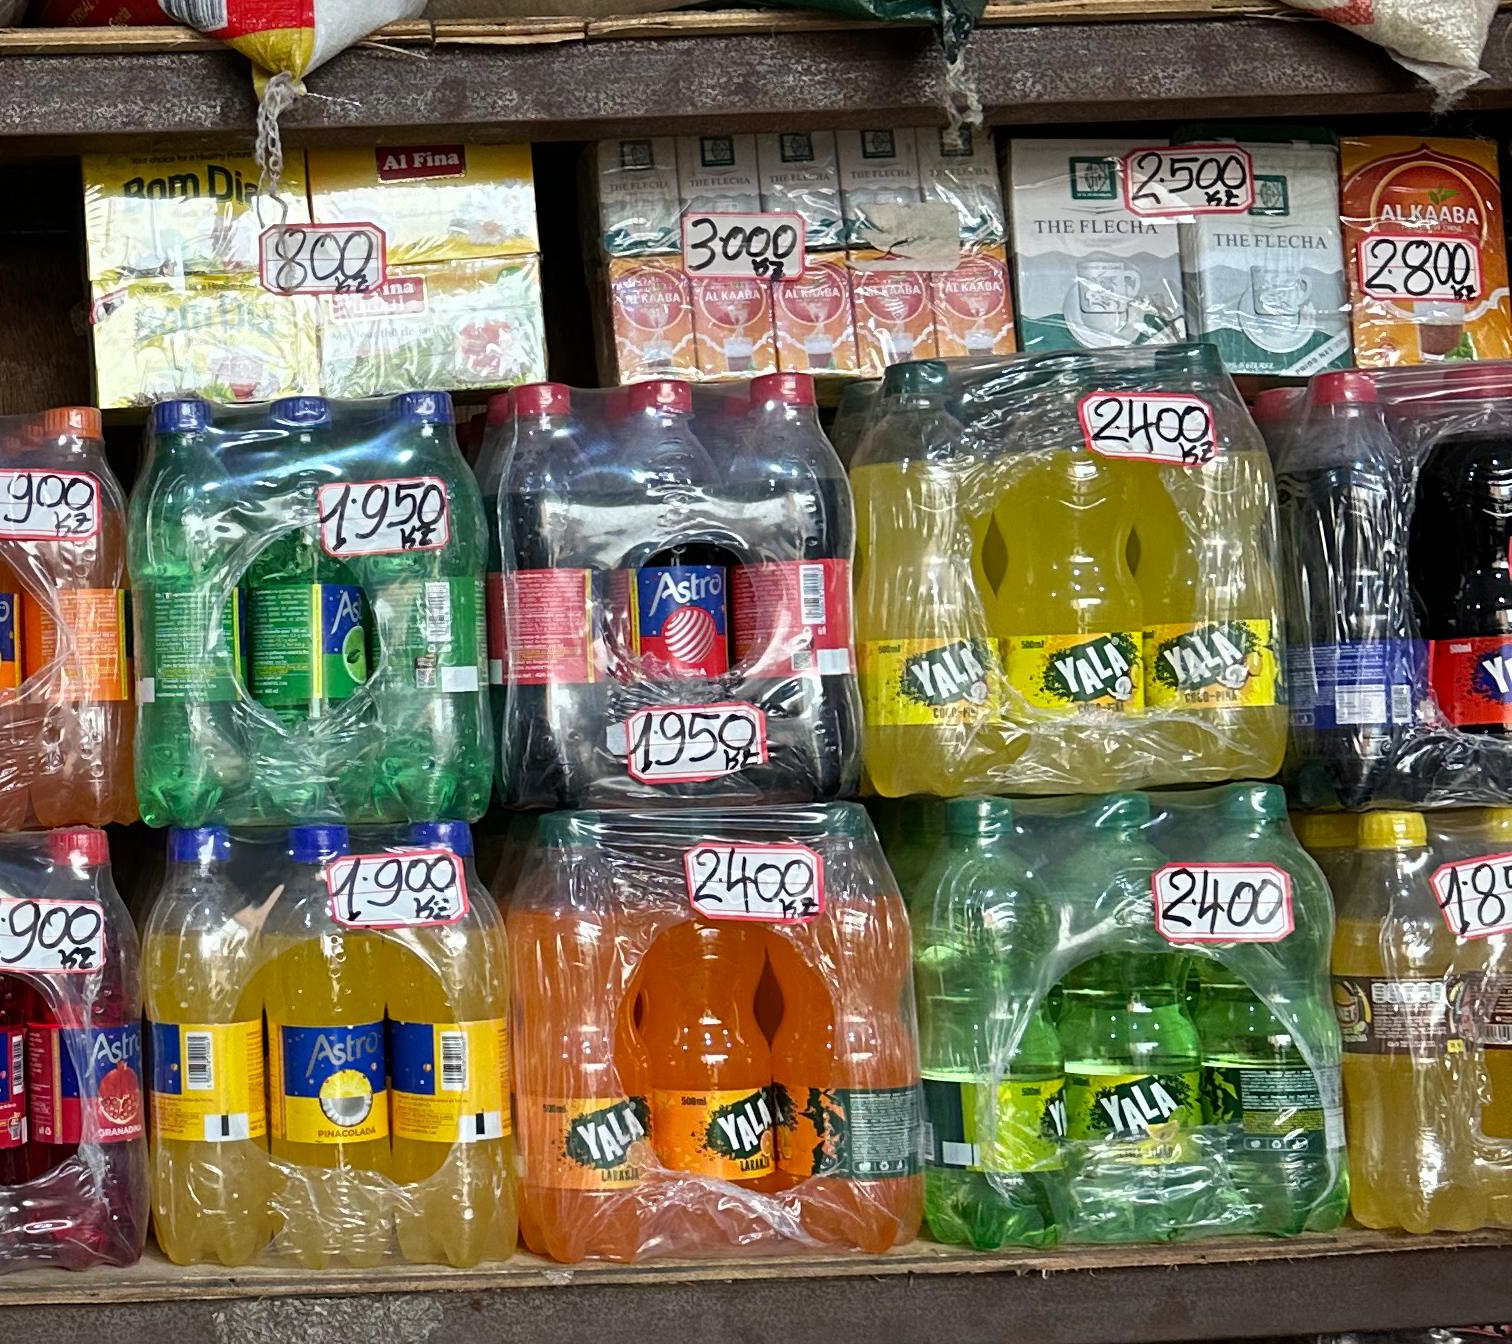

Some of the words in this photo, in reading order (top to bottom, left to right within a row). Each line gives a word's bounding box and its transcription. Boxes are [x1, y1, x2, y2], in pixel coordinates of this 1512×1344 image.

[412, 150, 460, 170] Fina
[1131, 151, 1248, 206] 2.500
[688, 217, 797, 271] 3.000
[1033, 219, 1079, 236] THE
[1081, 218, 1160, 236] FLECHA
[1212, 233, 1251, 249] THE
[1253, 232, 1329, 250] FLECHA
[274, 229, 374, 292] 800
[1364, 239, 1472, 296] 2.800
[1091, 396, 1210, 447] 2.400
[319, 482, 448, 552] 1.950
[647, 570, 724, 619] Astro
[1053, 636, 1129, 701] YALA
[327, 857, 457, 921] 1.900
[694, 846, 813, 914] 2.400
[1161, 868, 1284, 936] 2.400
[305, 1031, 380, 1080] Astro
[576, 1099, 645, 1164] YALA
[715, 1093, 772, 1154] YALA
[1099, 1080, 1179, 1140] YALA
